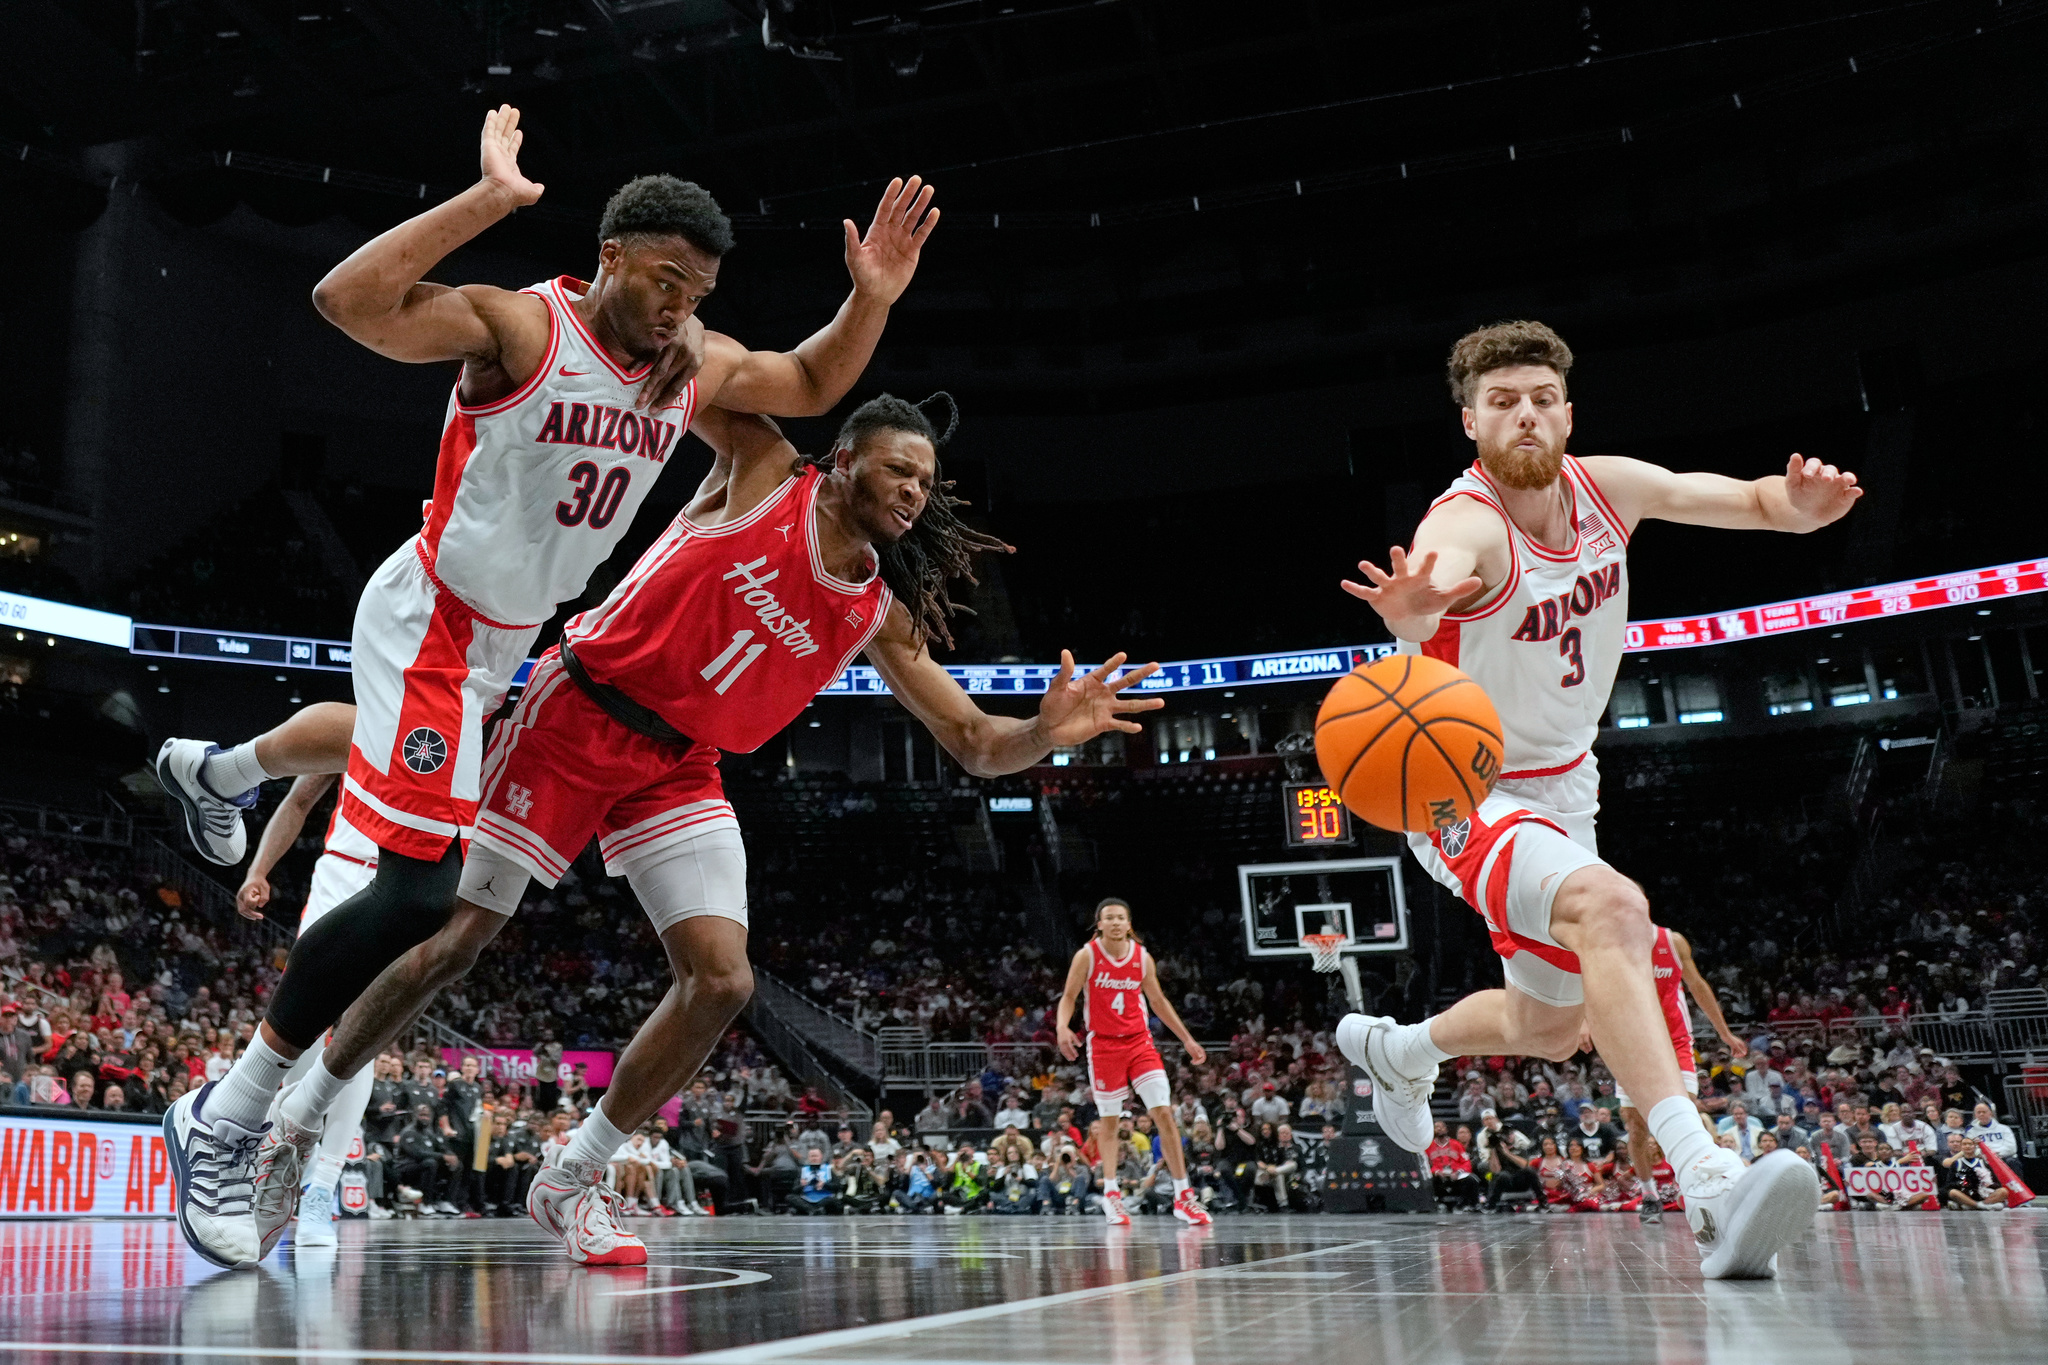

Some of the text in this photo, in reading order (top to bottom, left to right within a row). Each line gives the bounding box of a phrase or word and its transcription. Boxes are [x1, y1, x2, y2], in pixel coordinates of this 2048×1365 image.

[556, 461, 631, 530] 30
[722, 555, 820, 659] Houston
[1819, 577, 2019, 622] 4/7 2/3 0/0 3
[1764, 605, 1798, 619] TEAM
[1662, 618, 1710, 633] TOL 4
[1765, 616, 1800, 630] STATS
[216, 637, 250, 655] Tulsa
[292, 645, 311, 660] 30
[1658, 632, 1695, 646] FOULS
[700, 629, 768, 696] 11
[1560, 627, 1585, 688] 3
[1201, 663, 1226, 684] 11
[1251, 653, 1342, 679] ARIZONA
[968, 678, 992, 691] 2/2
[1014, 678, 1025, 691] 6
[1141, 675, 1191, 689] FOULS 2
[989, 797, 1034, 811] UMB
[1296, 788, 1343, 808] 13:54
[1299, 806, 1340, 839] 30
[1094, 972, 1141, 991] Houston
[1111, 991, 1126, 1015] 4
[1848, 1169, 1934, 1194] COOGS
[345, 1187, 365, 1205] 66
